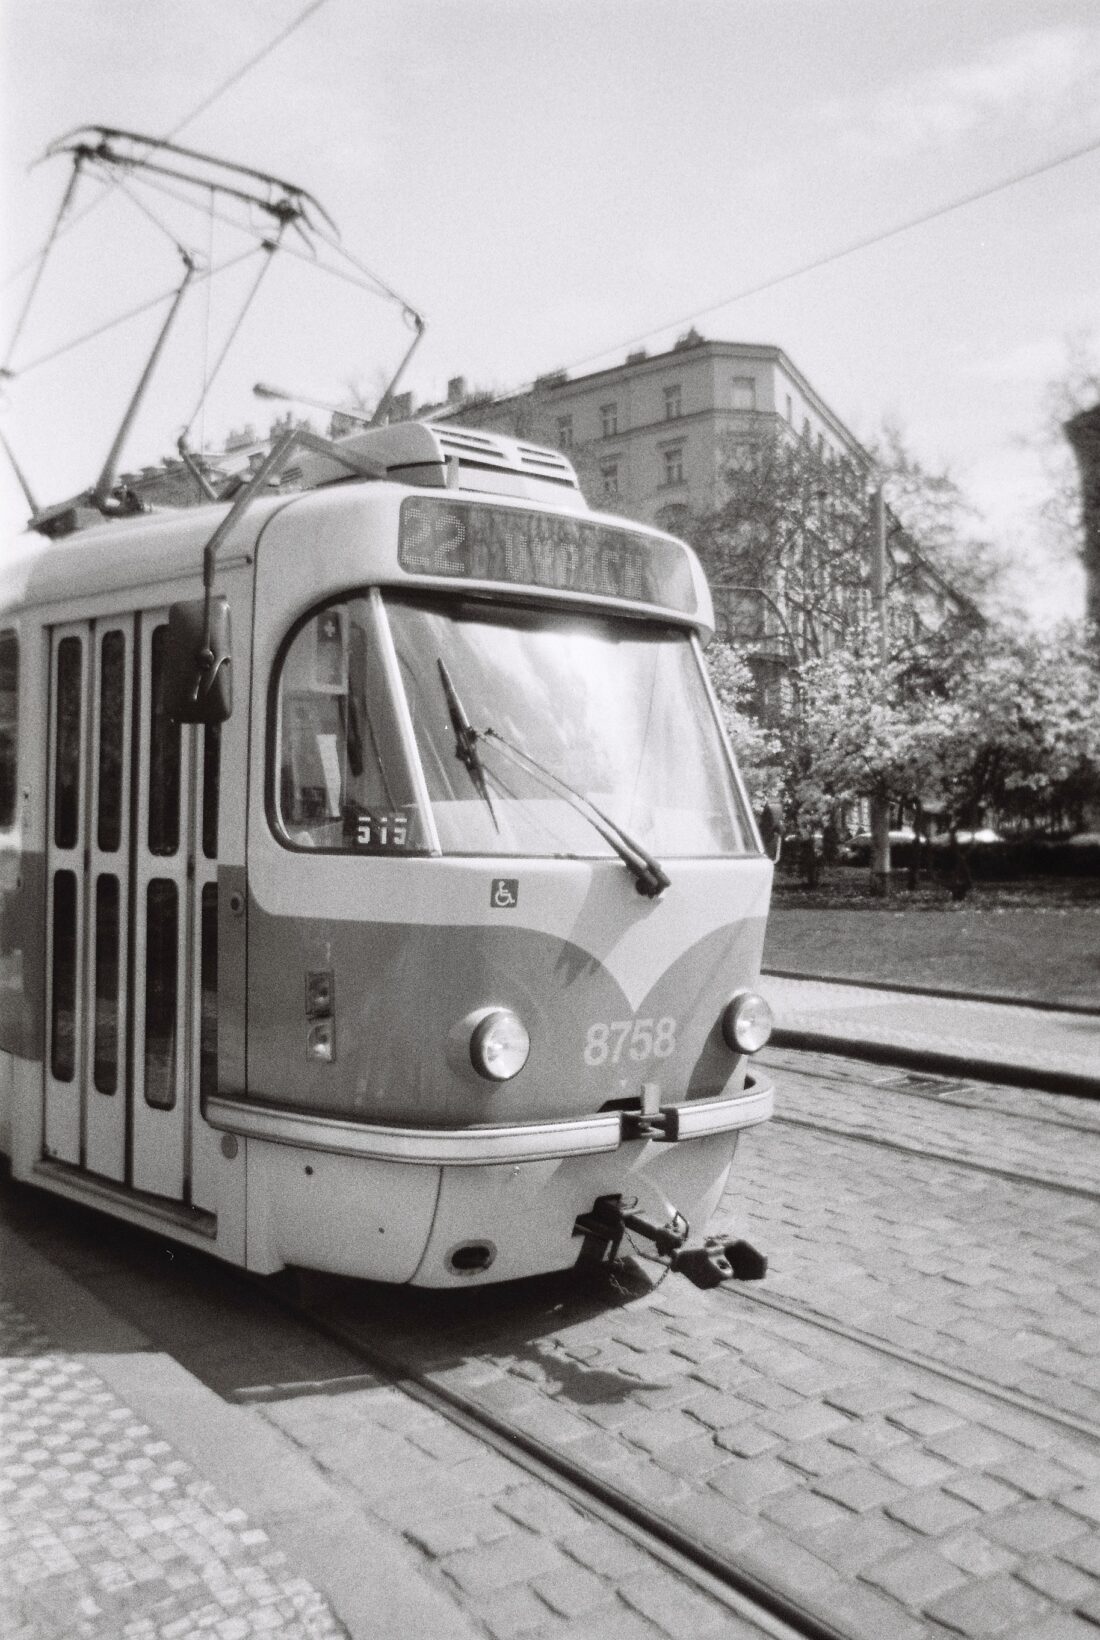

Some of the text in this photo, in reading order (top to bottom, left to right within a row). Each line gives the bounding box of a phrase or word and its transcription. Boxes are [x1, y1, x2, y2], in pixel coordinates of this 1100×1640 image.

[401, 507, 466, 573] 22
[357, 816, 408, 845] 515
[583, 1016, 677, 1066] 8758
